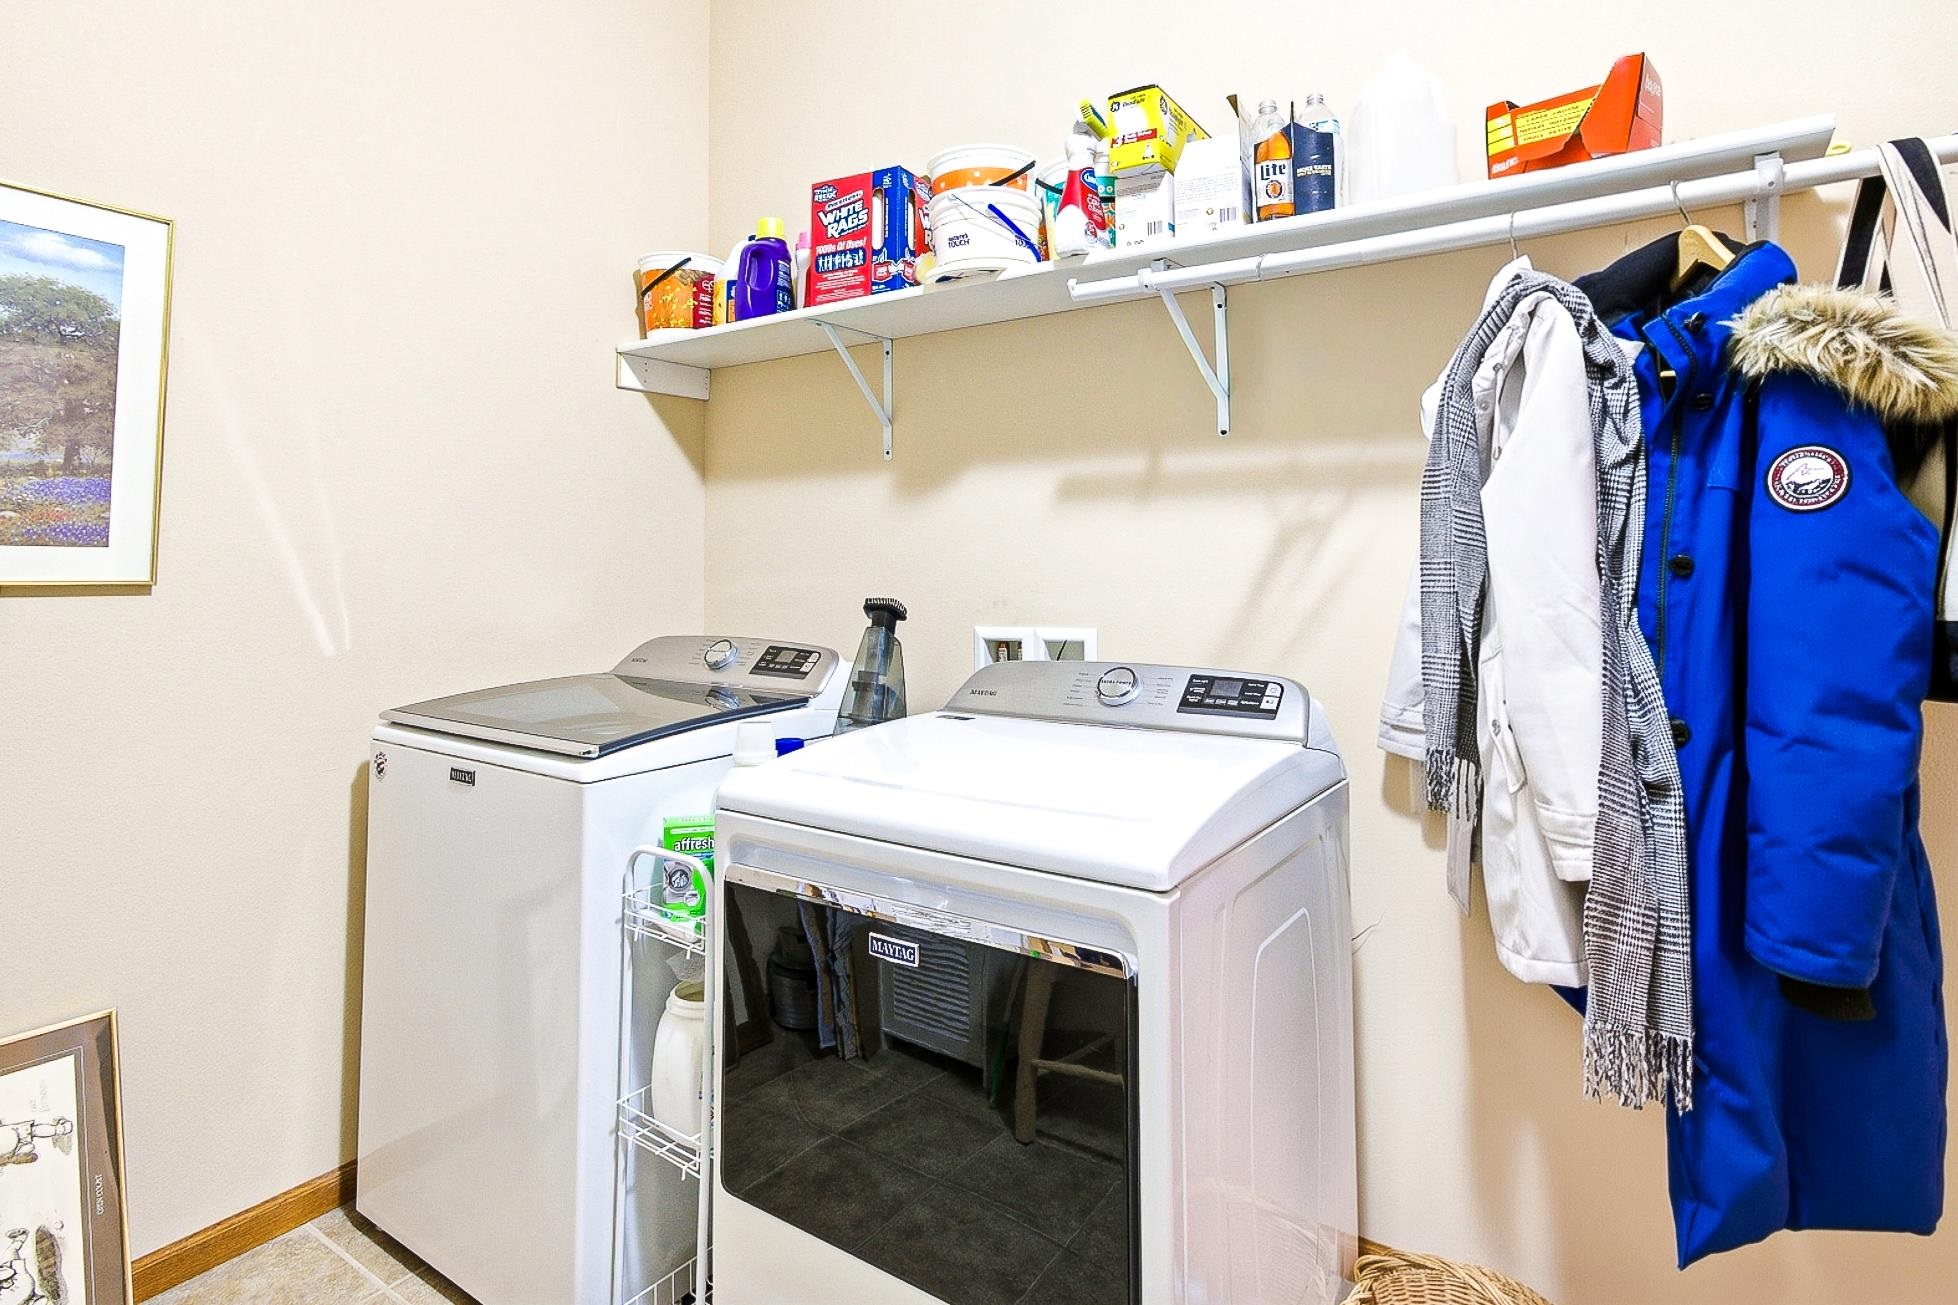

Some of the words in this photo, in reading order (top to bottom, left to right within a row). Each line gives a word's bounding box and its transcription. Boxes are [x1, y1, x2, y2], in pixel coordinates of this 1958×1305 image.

[1260, 163, 1286, 181] Lite
[818, 200, 864, 226] WHITE
[827, 208, 869, 238] RAGS
[674, 836, 714, 852] affresh
[871, 939, 915, 961] MAYTAG
